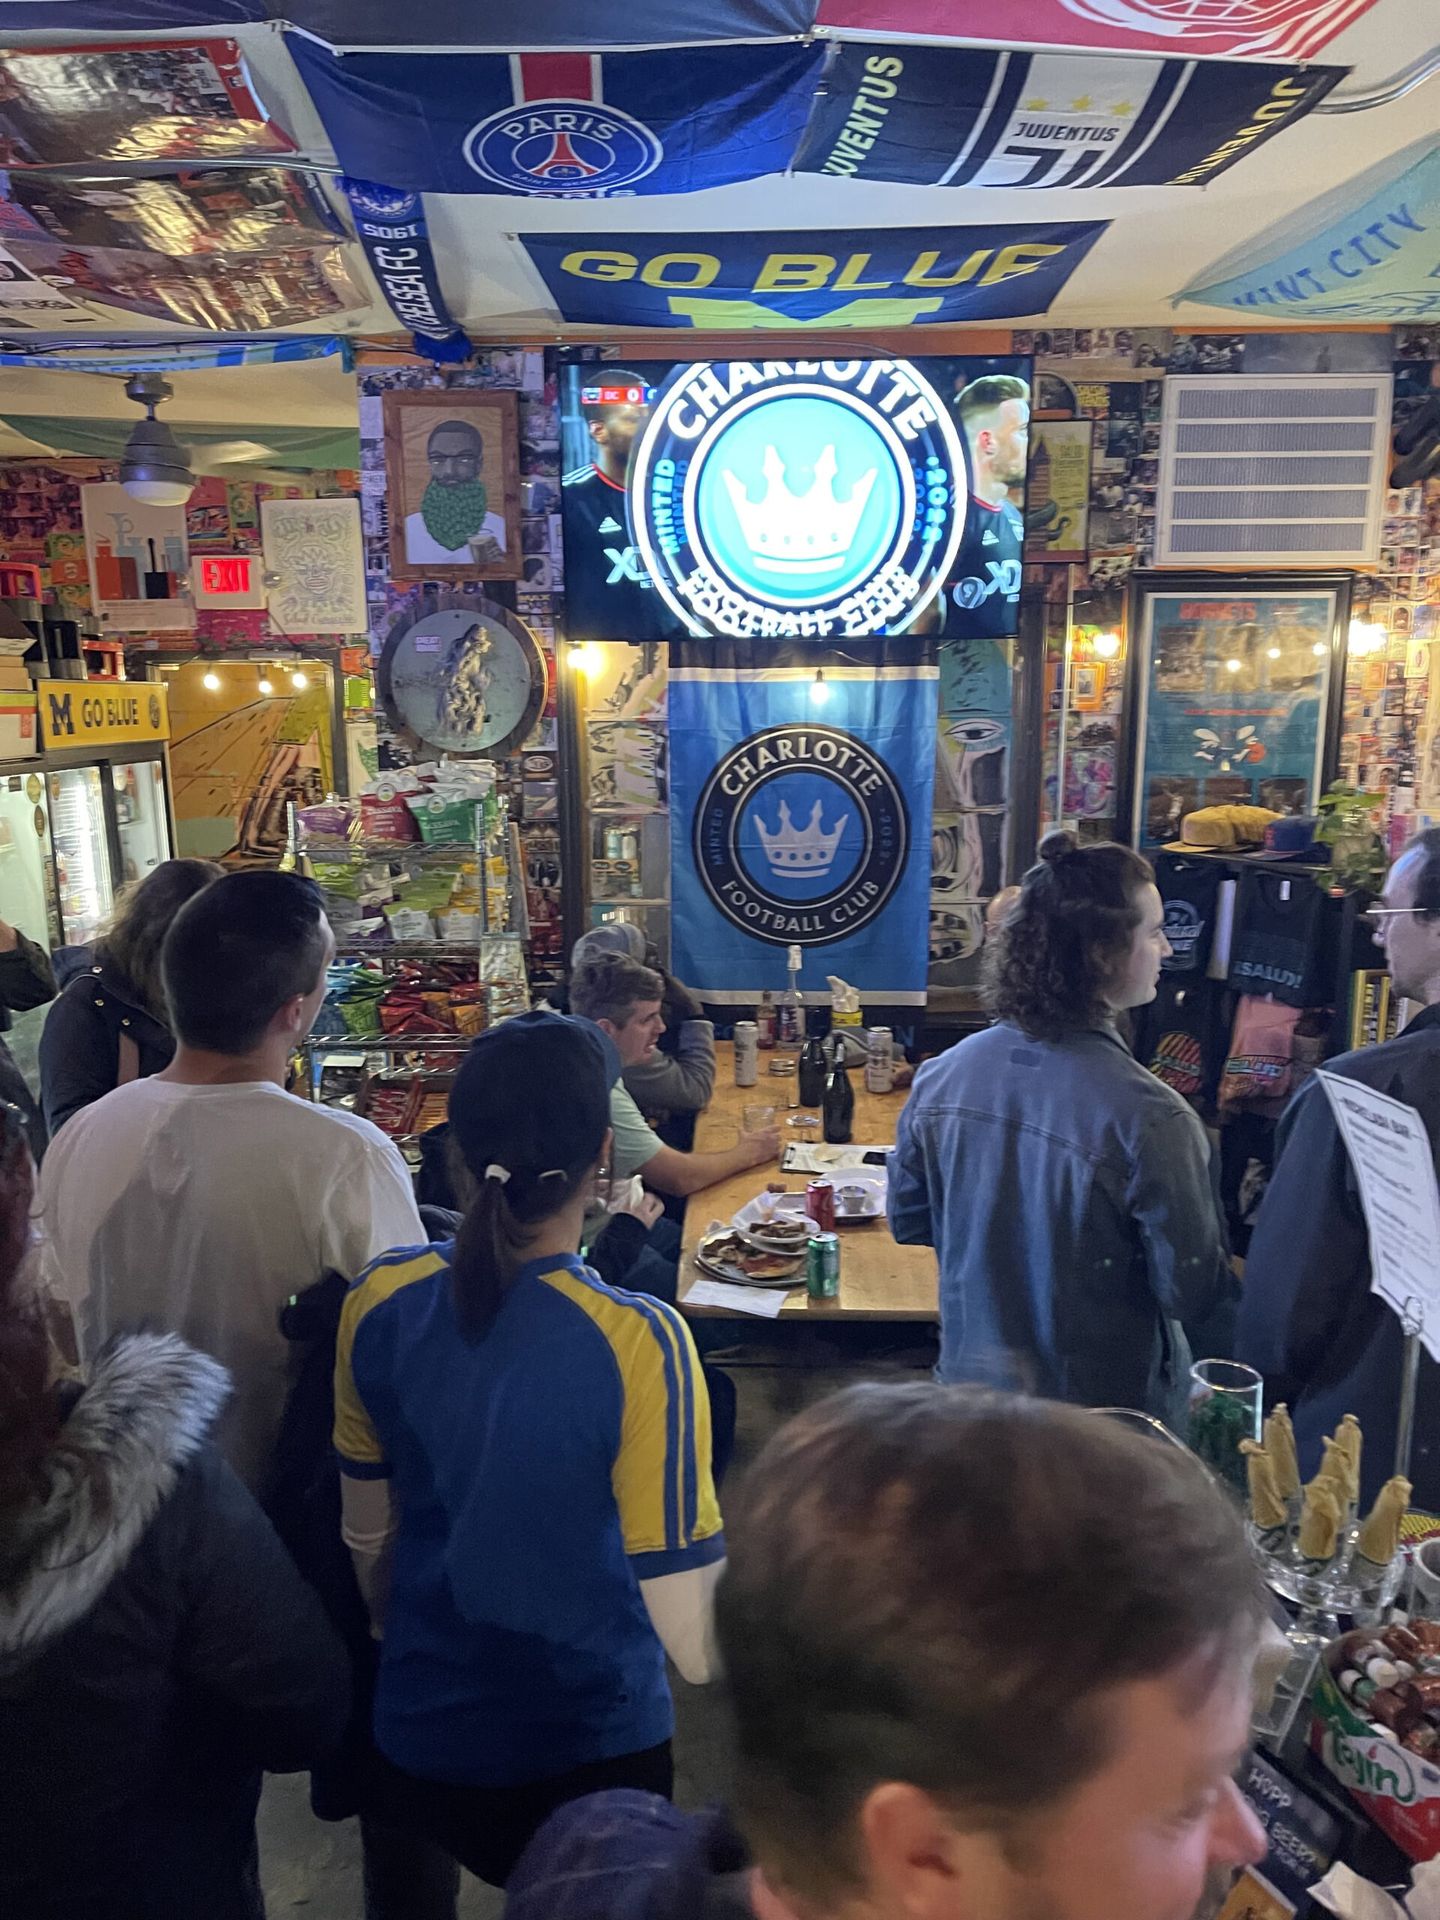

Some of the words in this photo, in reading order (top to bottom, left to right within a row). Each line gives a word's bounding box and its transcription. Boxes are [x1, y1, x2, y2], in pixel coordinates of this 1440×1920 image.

[501, 113, 619, 141] PARIS
[1012, 121, 1120, 142] JUVENTUS
[362, 223, 420, 240] 1905
[1327, 202, 1428, 279] CITY
[373, 246, 422, 271] FC
[560, 250, 722, 289] GO
[651, 458, 681, 556] MINTED
[202, 558, 251, 593] EXIT
[82, 698, 103, 728] GO
[106, 698, 139, 726] BLUE
[720, 736, 884, 797] CHARLOTTE
[721, 880, 825, 933] FOOTBALL
[830, 880, 880, 924] CLUB
